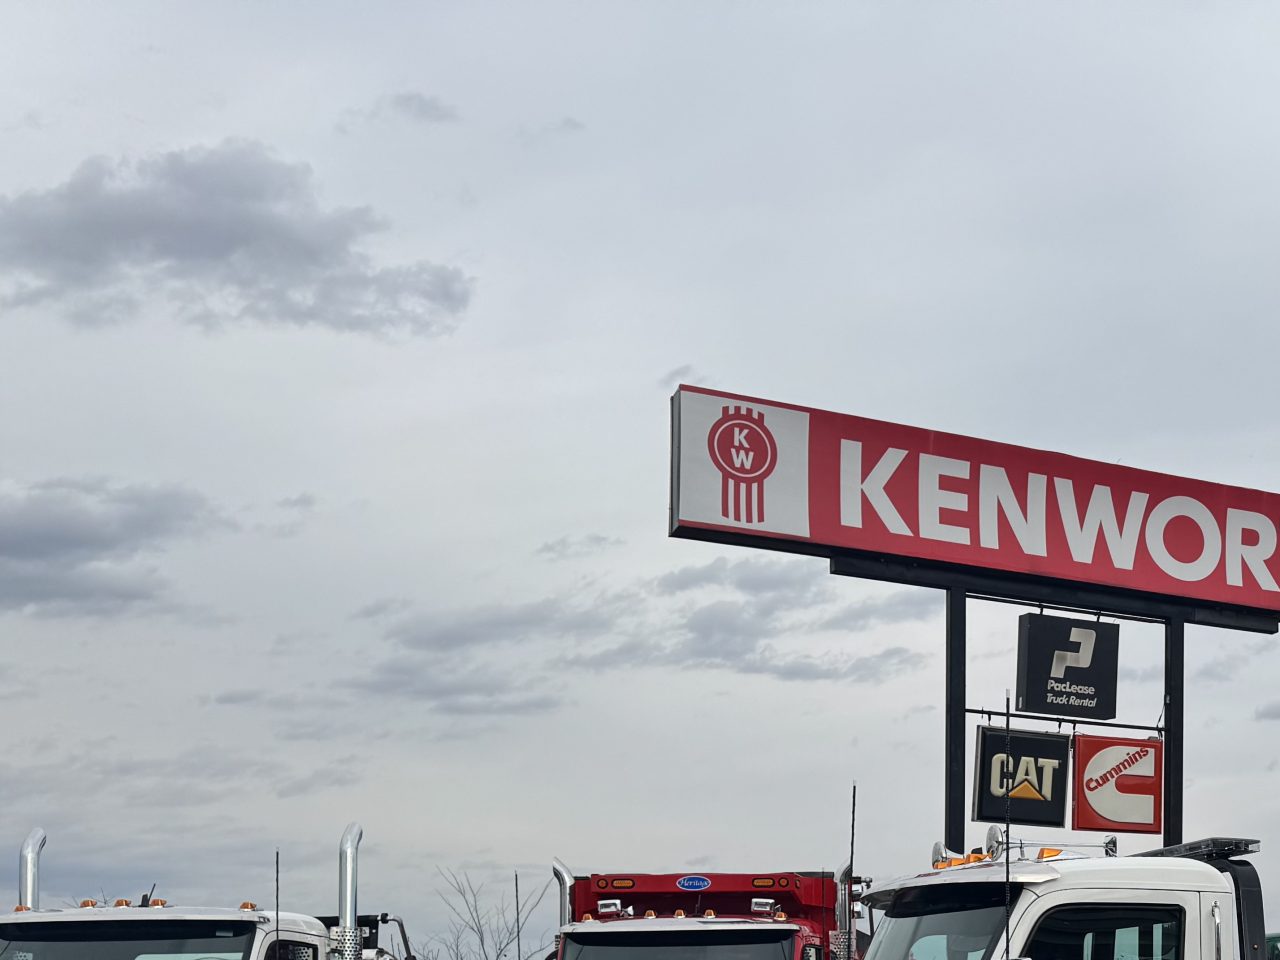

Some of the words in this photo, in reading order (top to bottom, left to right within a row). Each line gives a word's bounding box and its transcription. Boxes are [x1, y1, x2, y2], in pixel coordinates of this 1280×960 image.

[733, 427, 750, 448] K
[730, 447, 754, 470] W
[1047, 679, 1095, 695] PacLease
[1046, 693, 1068, 704] Truck
[1068, 695, 1097, 708] Rental
[990, 753, 1060, 801] CAT
[1085, 747, 1150, 792] Cummins
